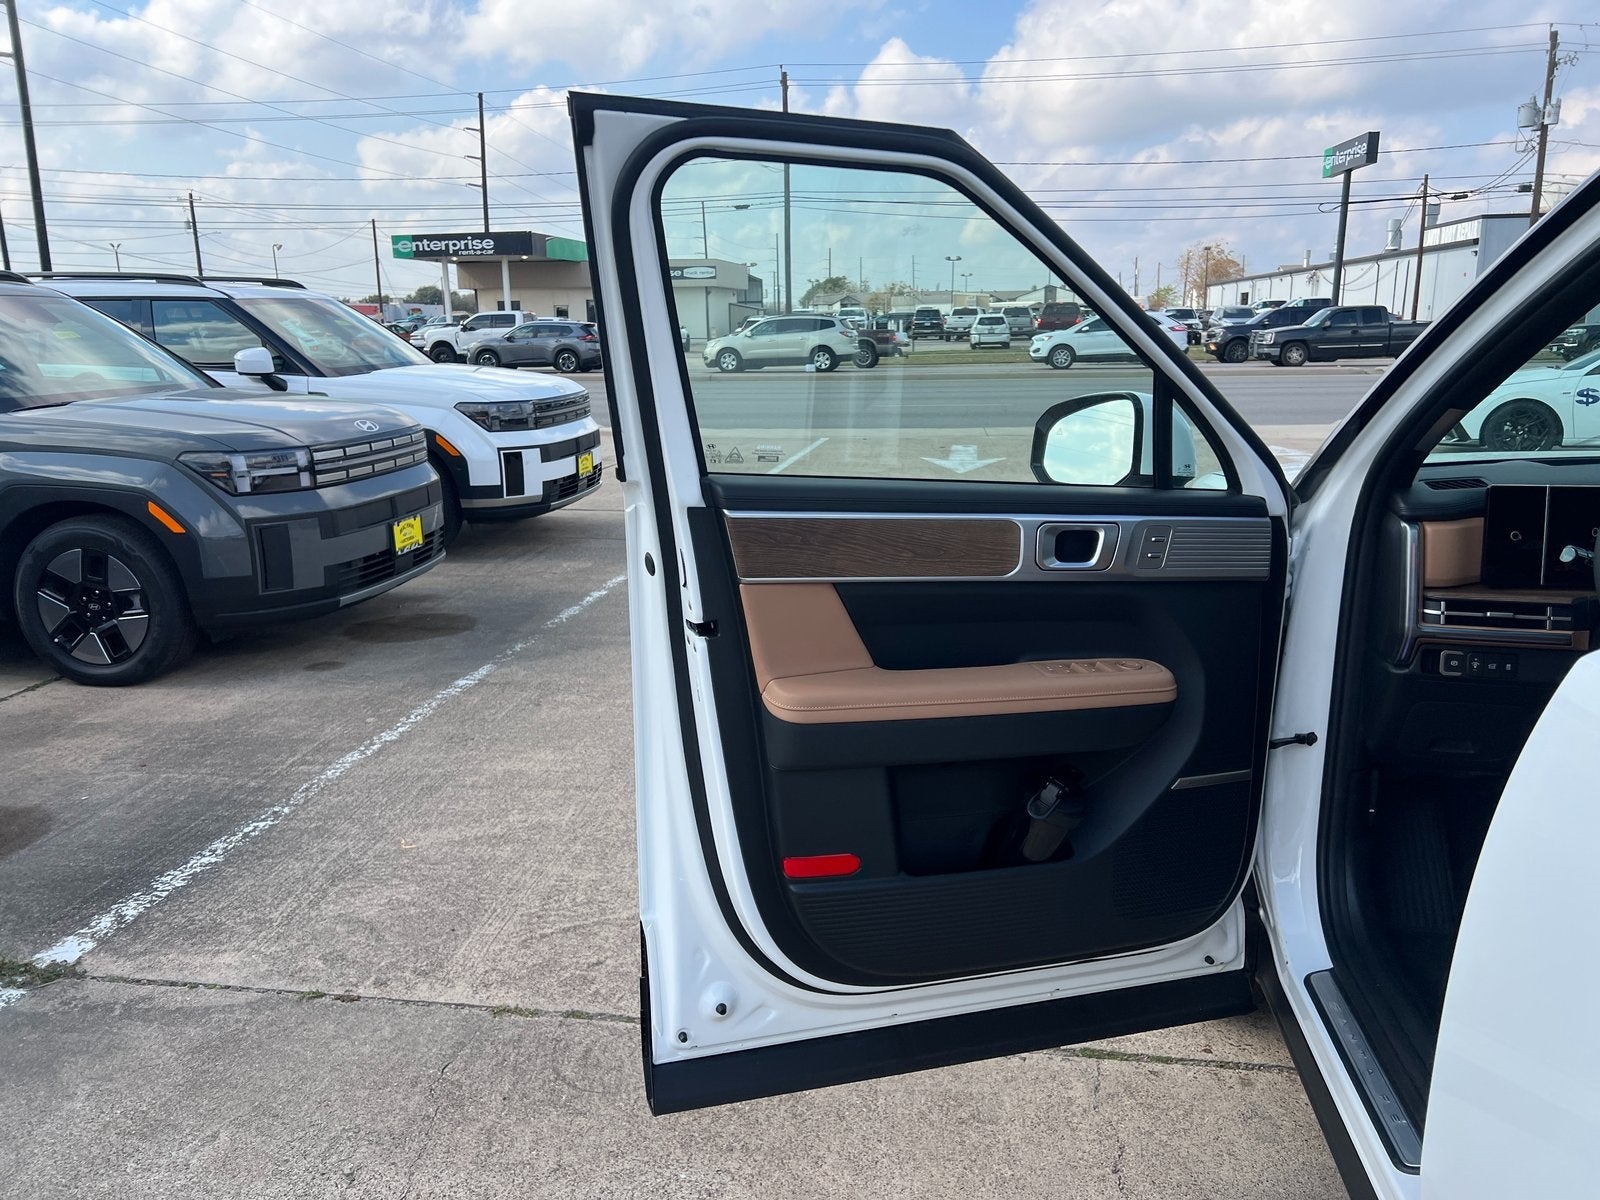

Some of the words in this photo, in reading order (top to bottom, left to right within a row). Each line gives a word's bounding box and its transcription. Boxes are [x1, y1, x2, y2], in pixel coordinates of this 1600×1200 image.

[1323, 141, 1367, 169] enterprise
[393, 236, 495, 253] enterprise
[458, 248, 495, 256] rent-a-car
